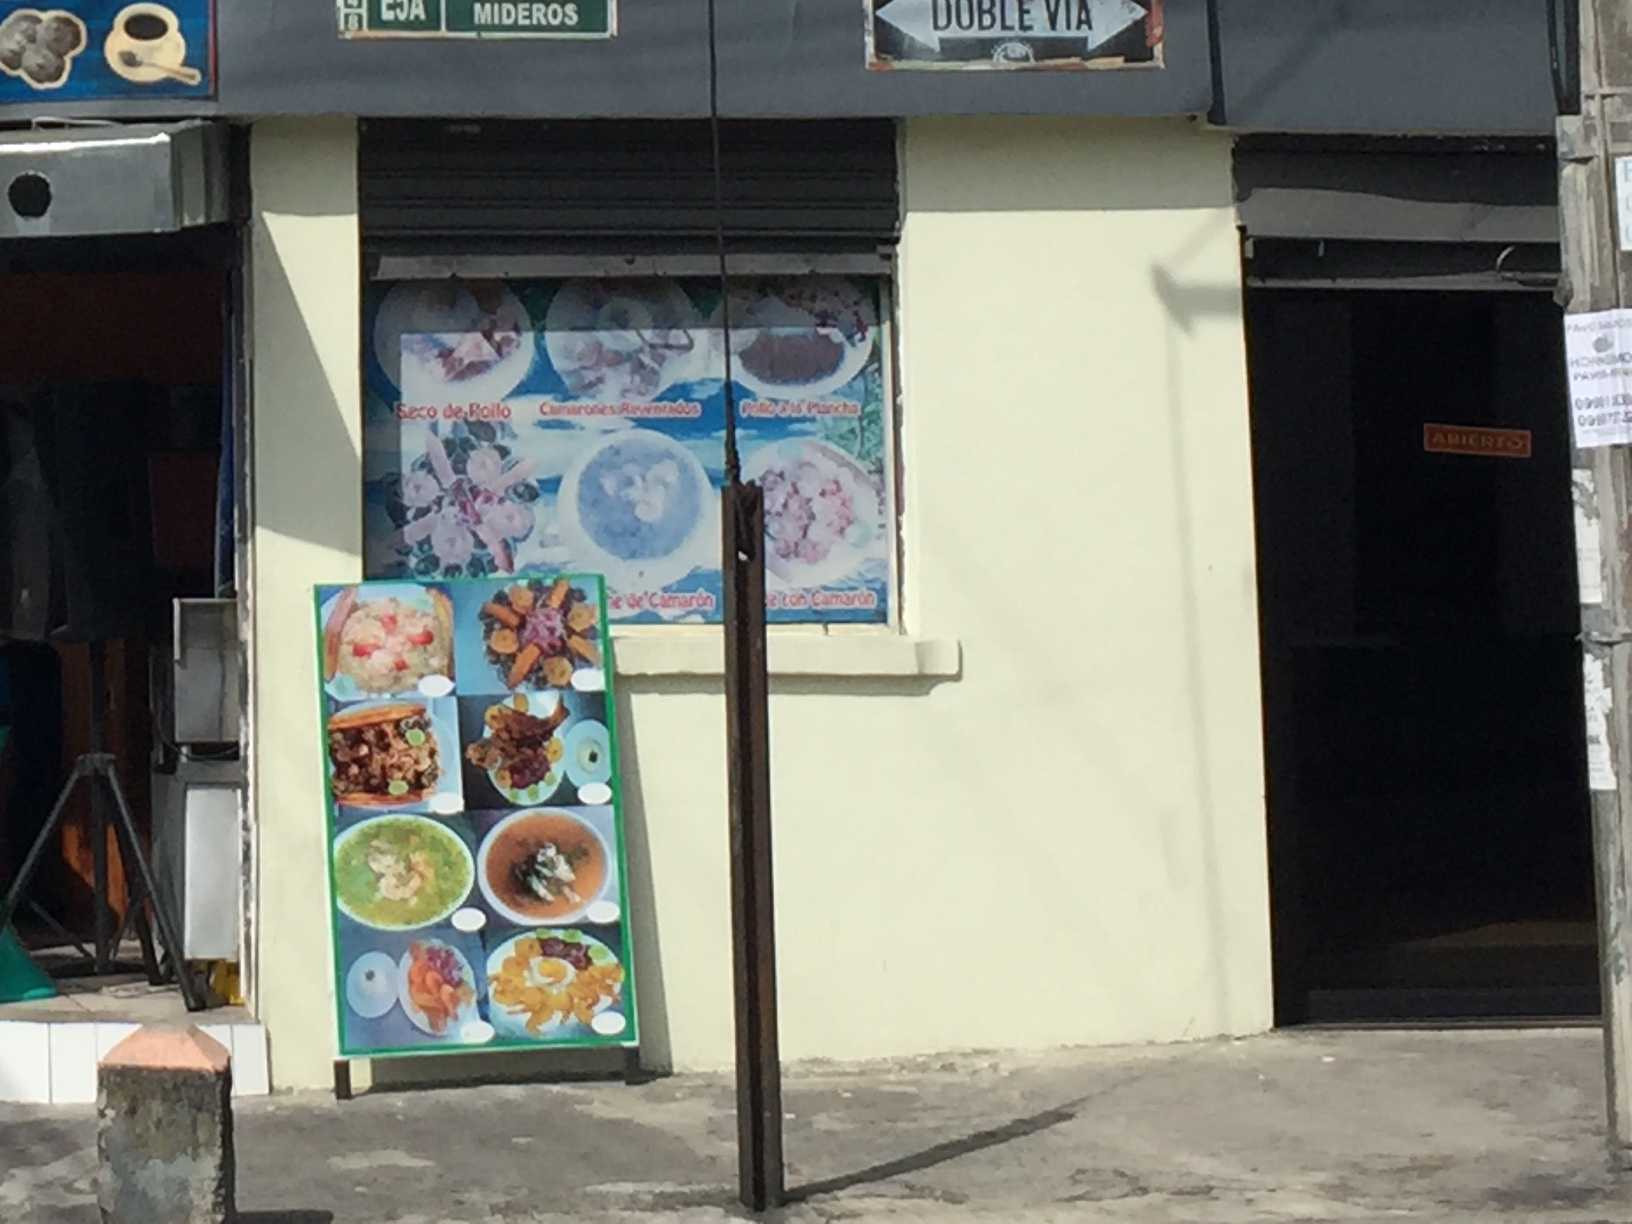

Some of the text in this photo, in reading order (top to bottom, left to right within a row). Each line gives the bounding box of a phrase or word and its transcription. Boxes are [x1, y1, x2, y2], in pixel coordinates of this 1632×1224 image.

[473, 2, 579, 26] MIDEROS
[443, 402, 463, 419] de
[1431, 432, 1524, 450] ABIERTO
